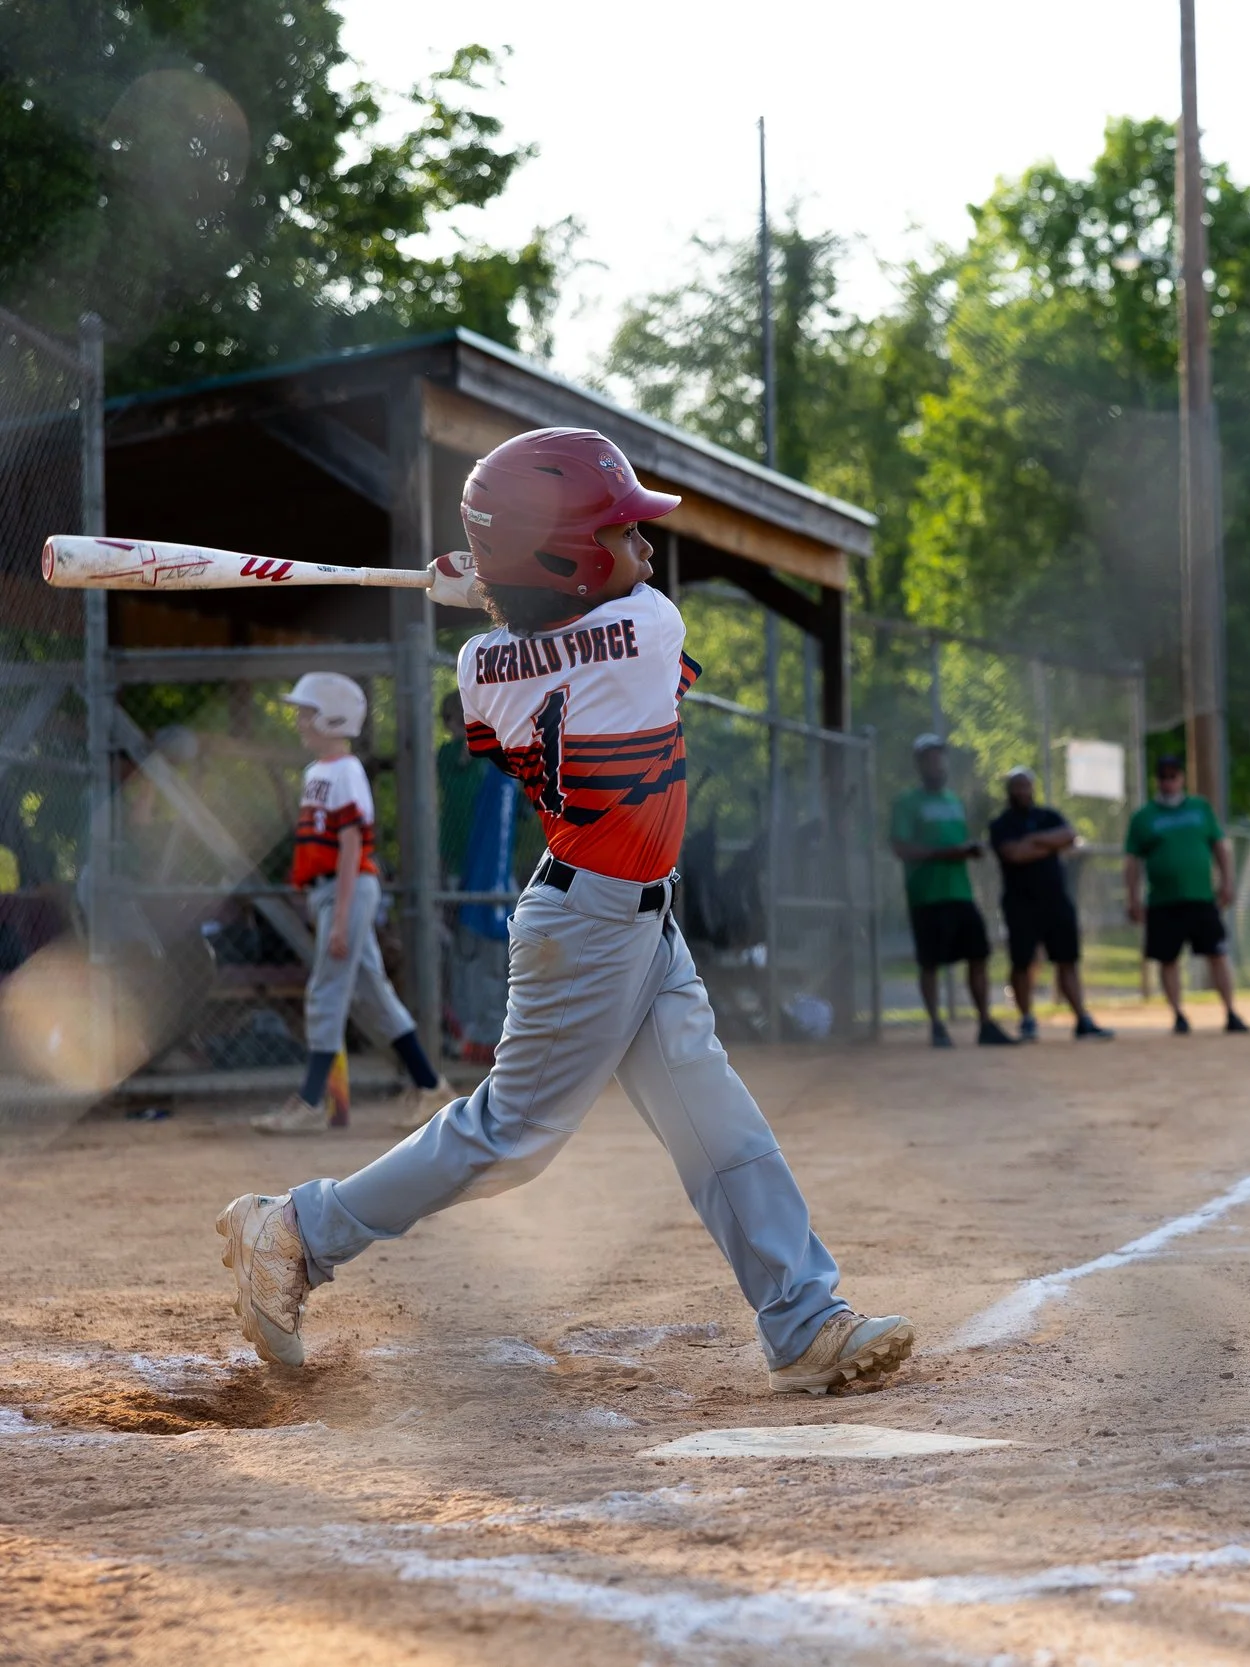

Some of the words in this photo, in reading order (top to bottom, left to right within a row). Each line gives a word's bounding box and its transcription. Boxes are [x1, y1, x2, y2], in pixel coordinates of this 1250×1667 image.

[476, 639, 563, 684] EMERALD
[563, 619, 639, 668] FORCE
[531, 684, 570, 818] 1
